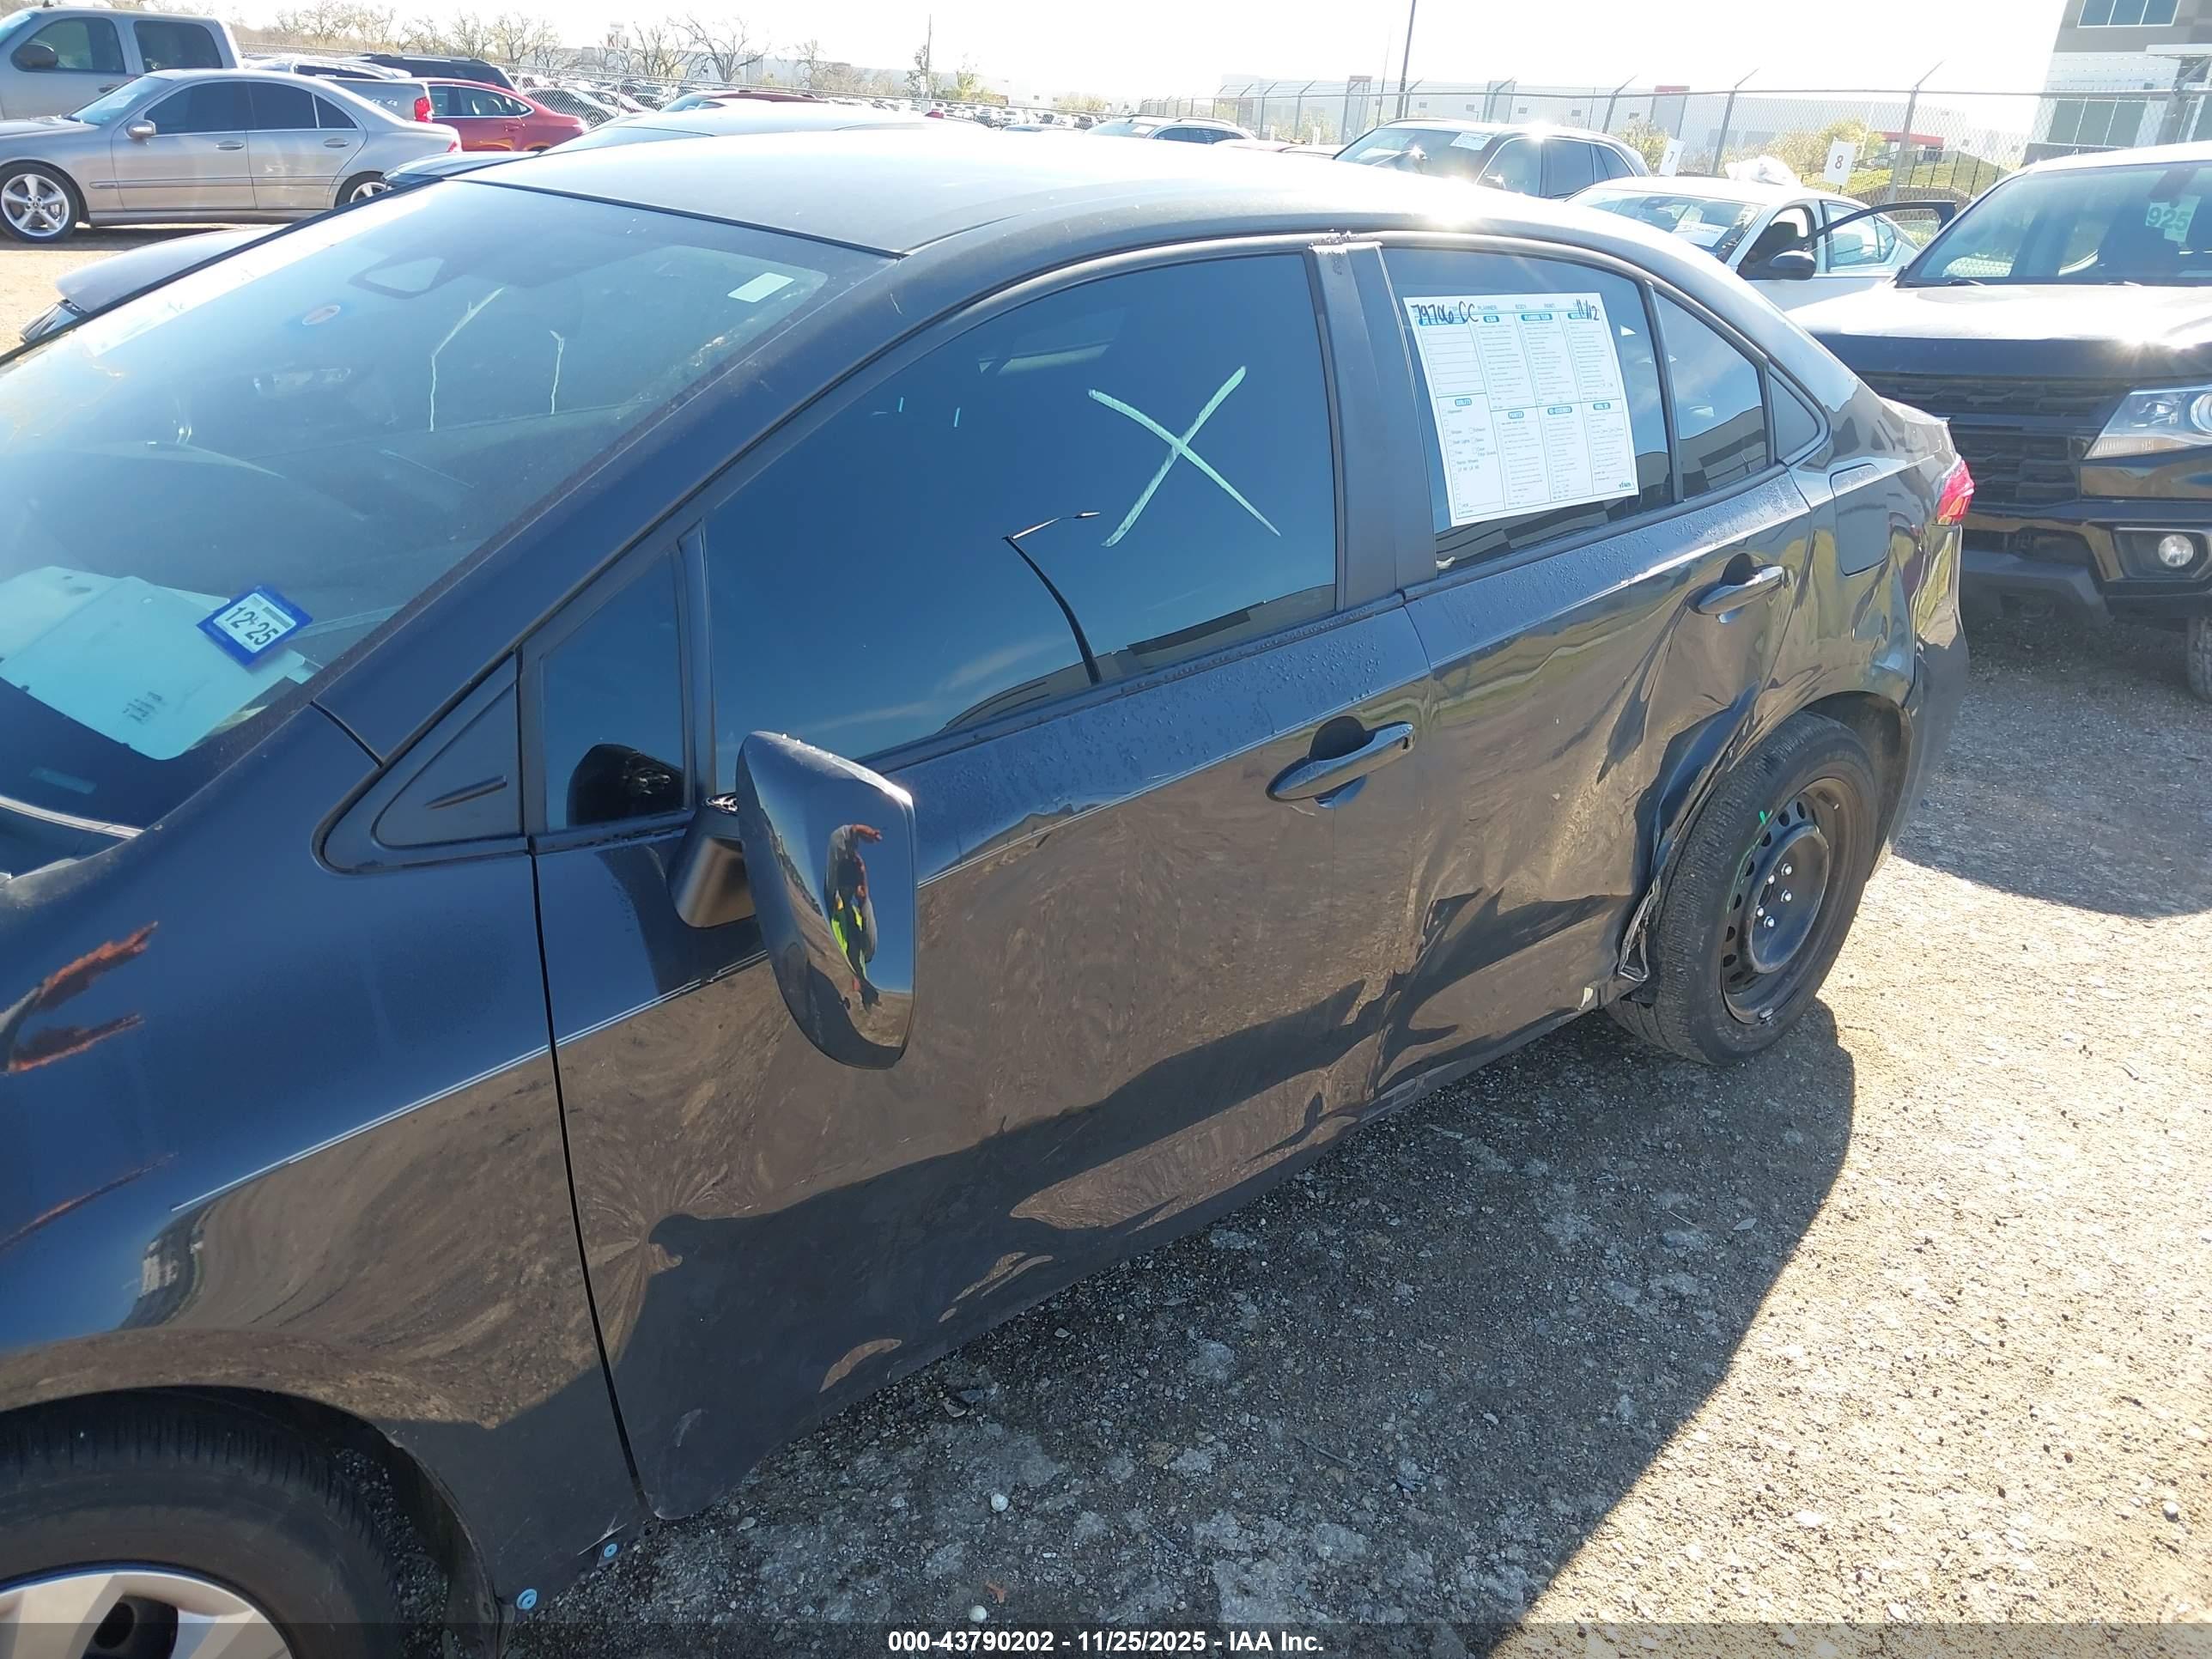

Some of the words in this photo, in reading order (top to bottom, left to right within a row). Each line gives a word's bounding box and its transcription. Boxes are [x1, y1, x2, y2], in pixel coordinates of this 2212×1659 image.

[607, 33, 615, 47] K
[1834, 155, 1844, 170] 8
[2147, 206, 2192, 232] 925
[225, 606, 256, 629] 12
[245, 622, 280, 646] 25
